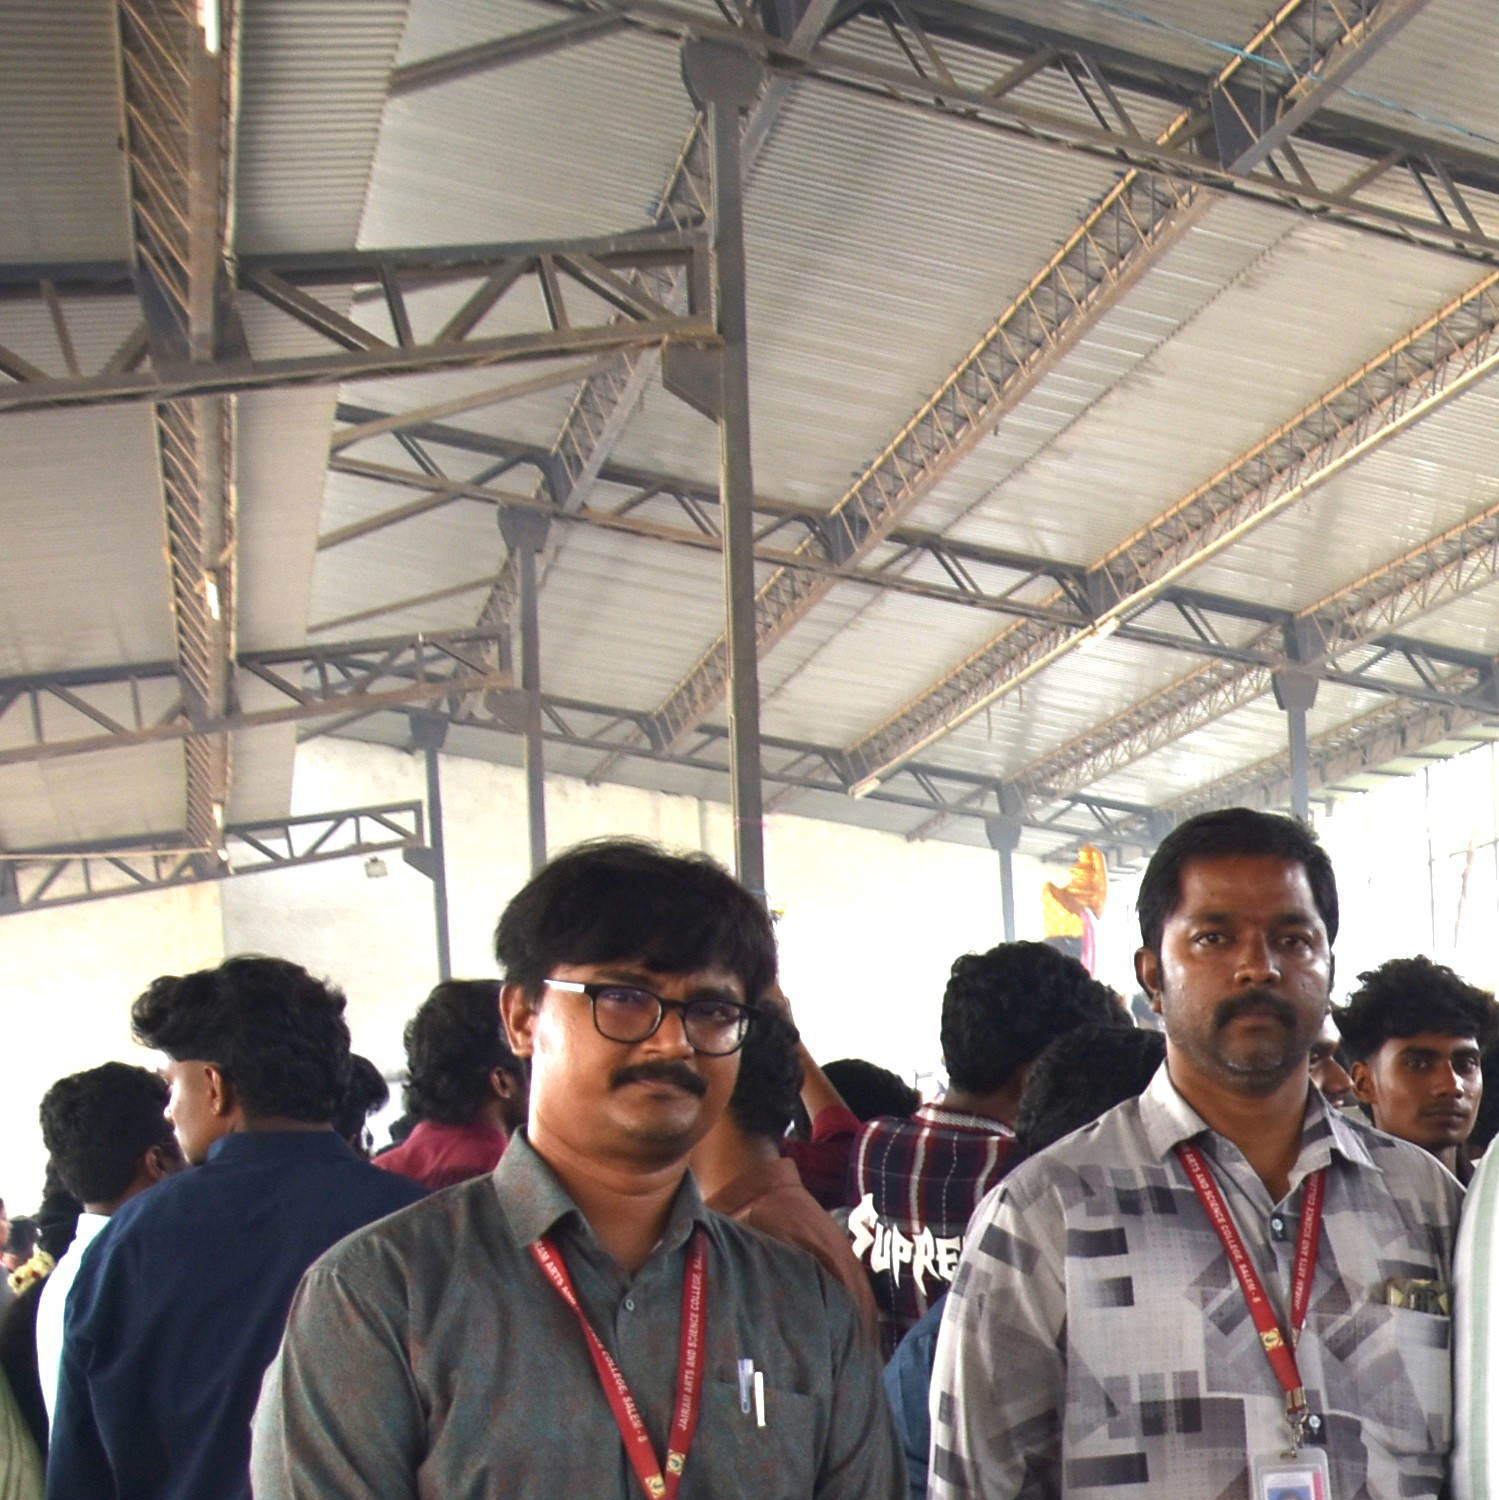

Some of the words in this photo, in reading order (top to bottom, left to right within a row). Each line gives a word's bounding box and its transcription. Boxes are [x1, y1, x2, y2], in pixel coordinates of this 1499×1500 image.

[1203, 1190, 1226, 1225] SCIENCE
[848, 1193, 967, 1296] SUPRE
[545, 1261, 564, 1287] ARTS
[687, 1311, 700, 1348] SCIENCE
[686, 1349, 697, 1368] AND
[683, 1369, 696, 1393] ARTS
[622, 1396, 643, 1429] SALEM
[678, 1394, 692, 1431] JAIRAM
